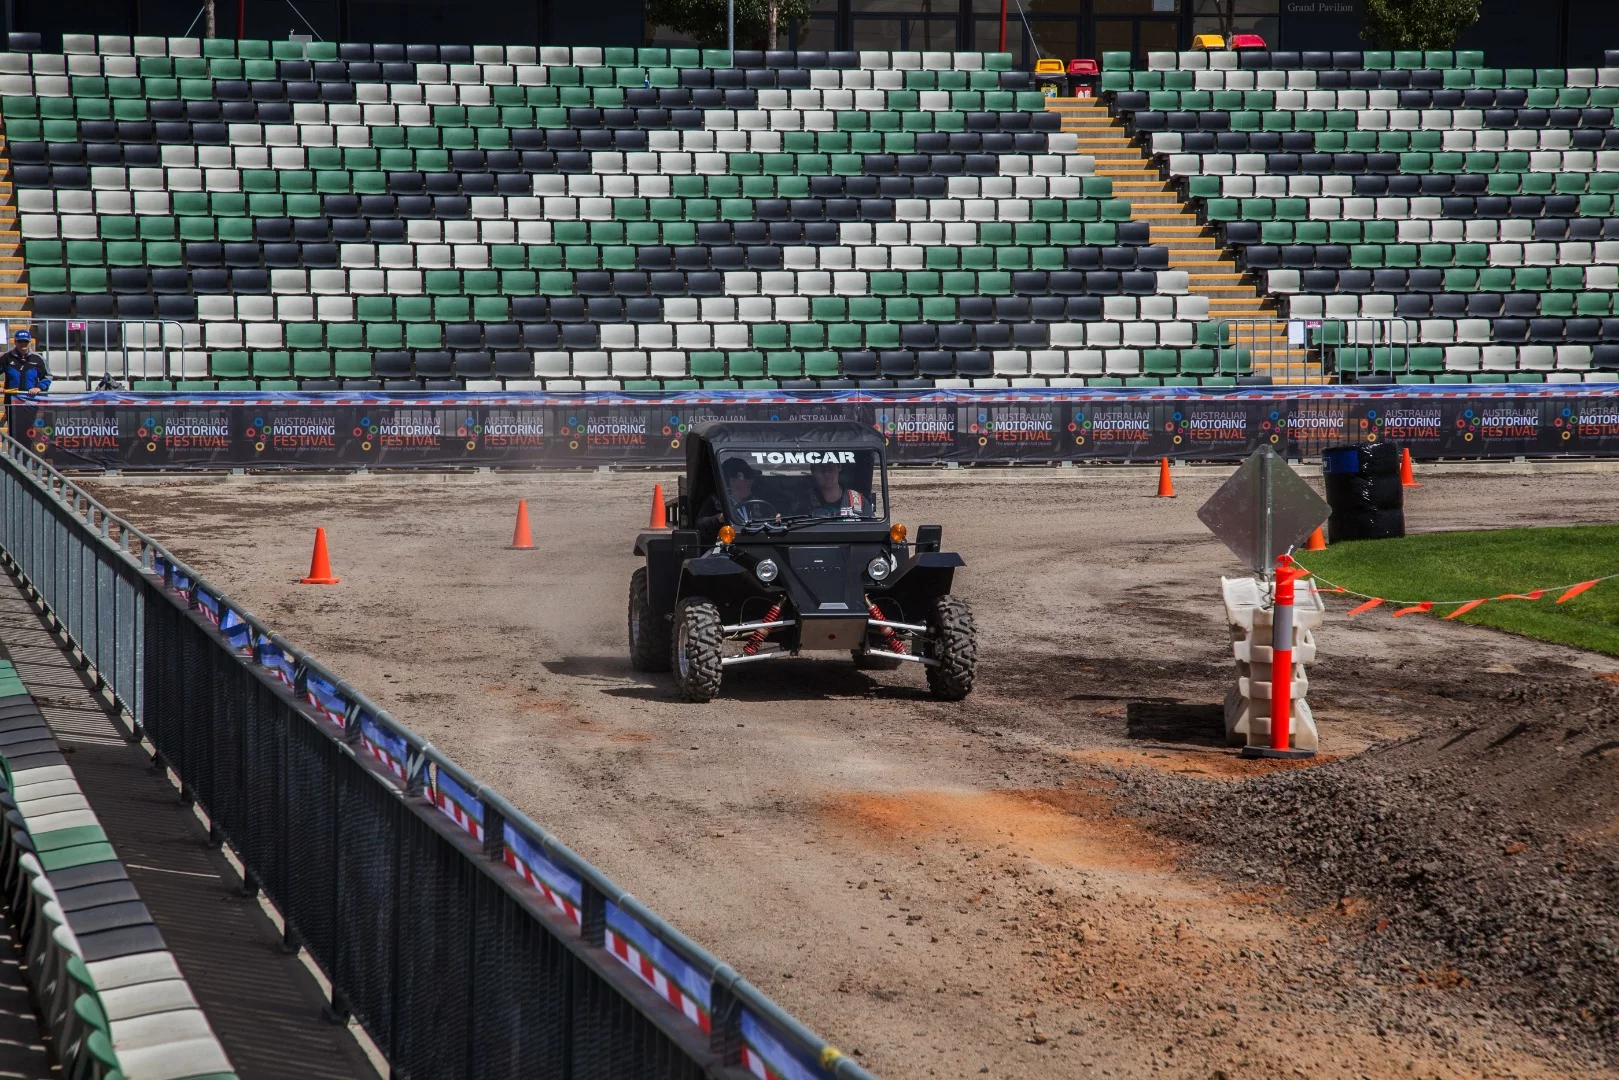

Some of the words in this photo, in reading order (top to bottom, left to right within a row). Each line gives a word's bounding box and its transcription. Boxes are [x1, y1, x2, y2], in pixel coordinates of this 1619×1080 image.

[1288, 3, 1315, 11] Grand
[1319, 3, 1353, 11] Pavilion
[55, 418, 118, 426] AUSTRALIAN
[996, 421, 1052, 430] MOTORING
[1093, 421, 1149, 429] MOTORING
[1190, 420, 1246, 429] MOTORING
[1288, 419, 1344, 428] MOTORING
[1385, 418, 1441, 426] MOTORING
[1482, 417, 1538, 426] MOTORING
[55, 426, 118, 436] MOTORING
[166, 426, 228, 435] MOTORING
[274, 426, 335, 435] MOTORING
[380, 426, 440, 434] MOTORING
[484, 425, 543, 434] MOTORING
[587, 425, 645, 434] MOTORING
[897, 422, 954, 431] MOTORING
[1482, 426, 1537, 436] FESTIVAL
[897, 432, 954, 441] FESTIVAL
[996, 431, 1052, 440] FESTIVAL
[1093, 430, 1148, 440] FESTIVAL
[1190, 429, 1246, 439] FESTIVAL
[1287, 428, 1343, 438] FESTIVAL
[1384, 427, 1440, 437] FESTIVAL
[56, 436, 119, 447] FESTIVAL
[166, 436, 228, 446] FESTIVAL
[274, 436, 335, 446] FESTIVAL
[380, 435, 440, 445] FESTIVAL
[484, 435, 543, 445] FESTIVAL
[587, 434, 646, 444] FESTIVAL
[751, 452, 856, 464] TOMCAR
